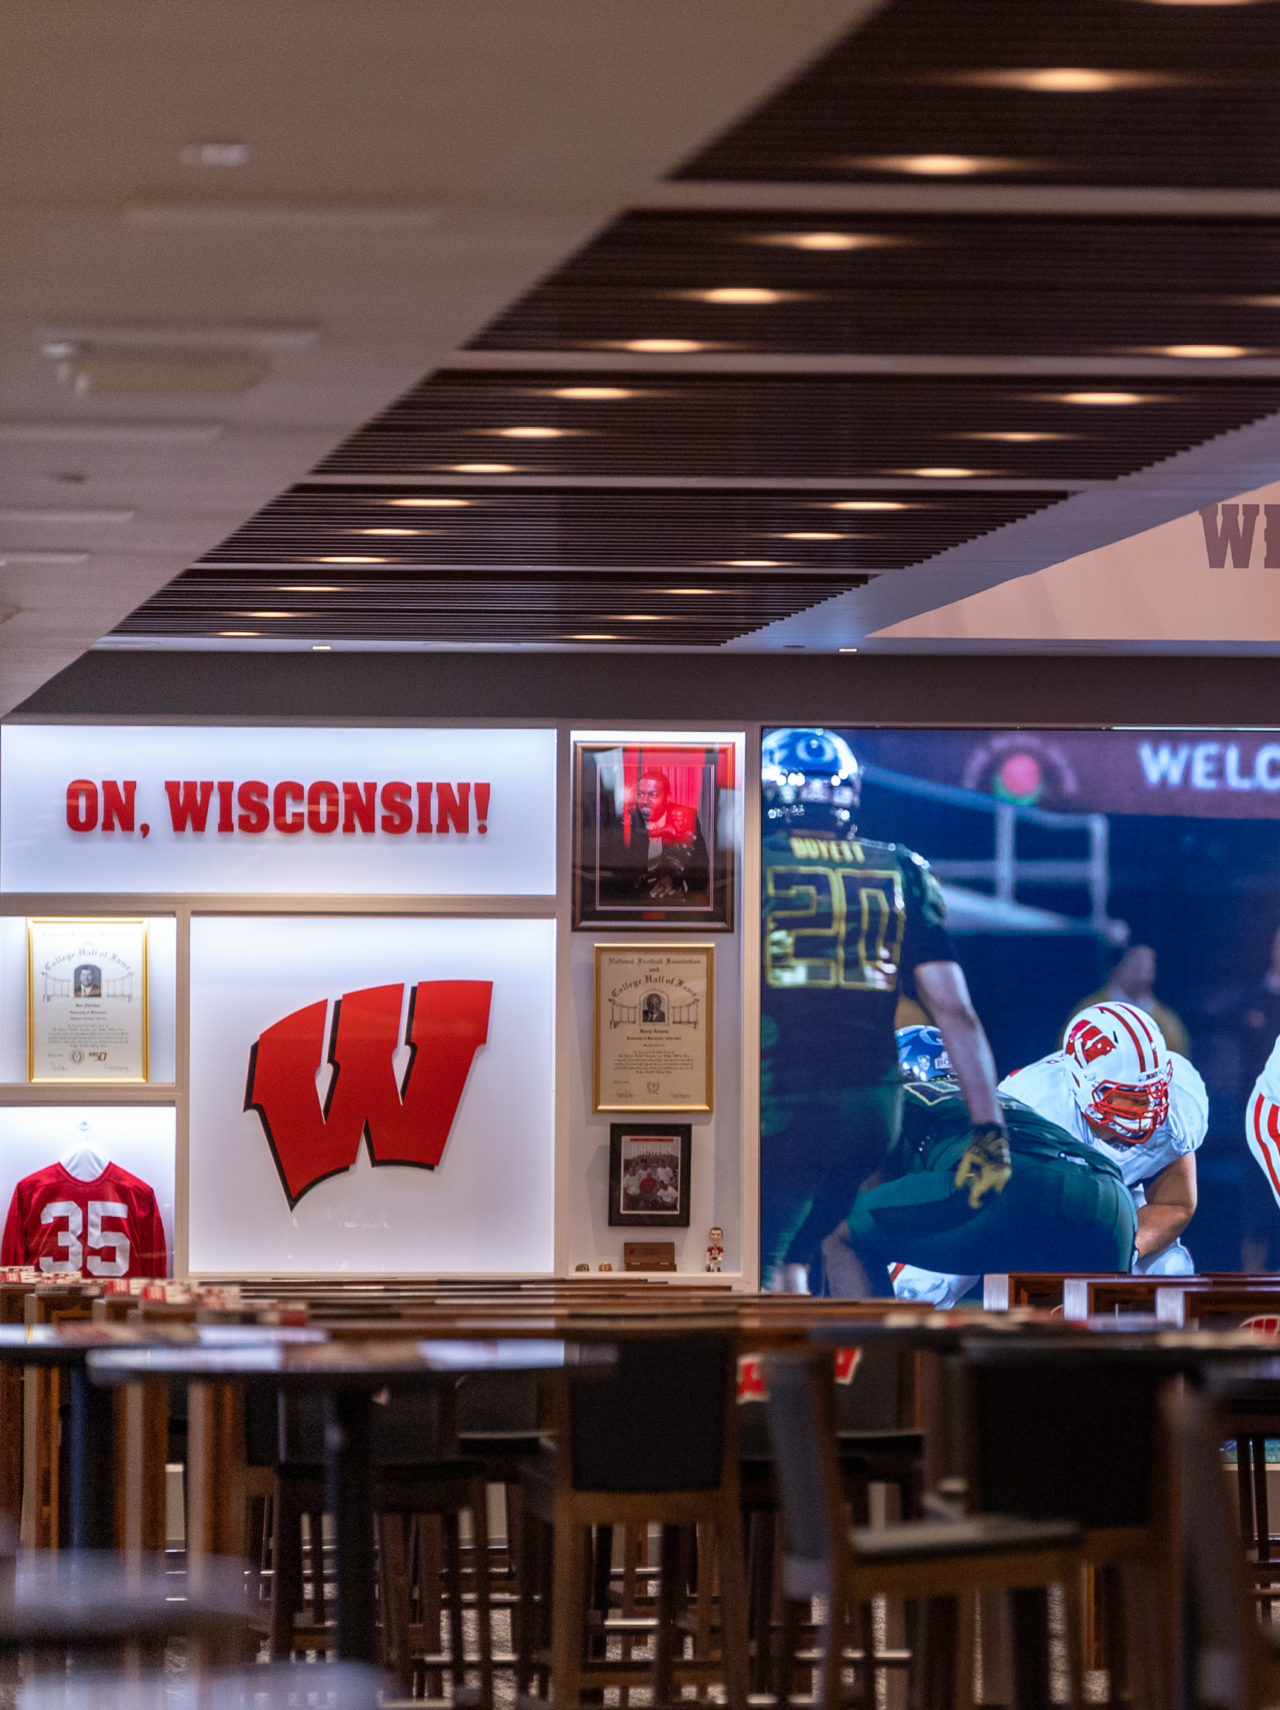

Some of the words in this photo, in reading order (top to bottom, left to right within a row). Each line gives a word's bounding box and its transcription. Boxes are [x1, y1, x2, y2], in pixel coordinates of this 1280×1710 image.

[66, 779, 151, 838] ON,
[164, 780, 491, 835] WISCONSIN!
[766, 865, 906, 992] 20
[243, 980, 493, 1212] W
[39, 1200, 130, 1277] 35
